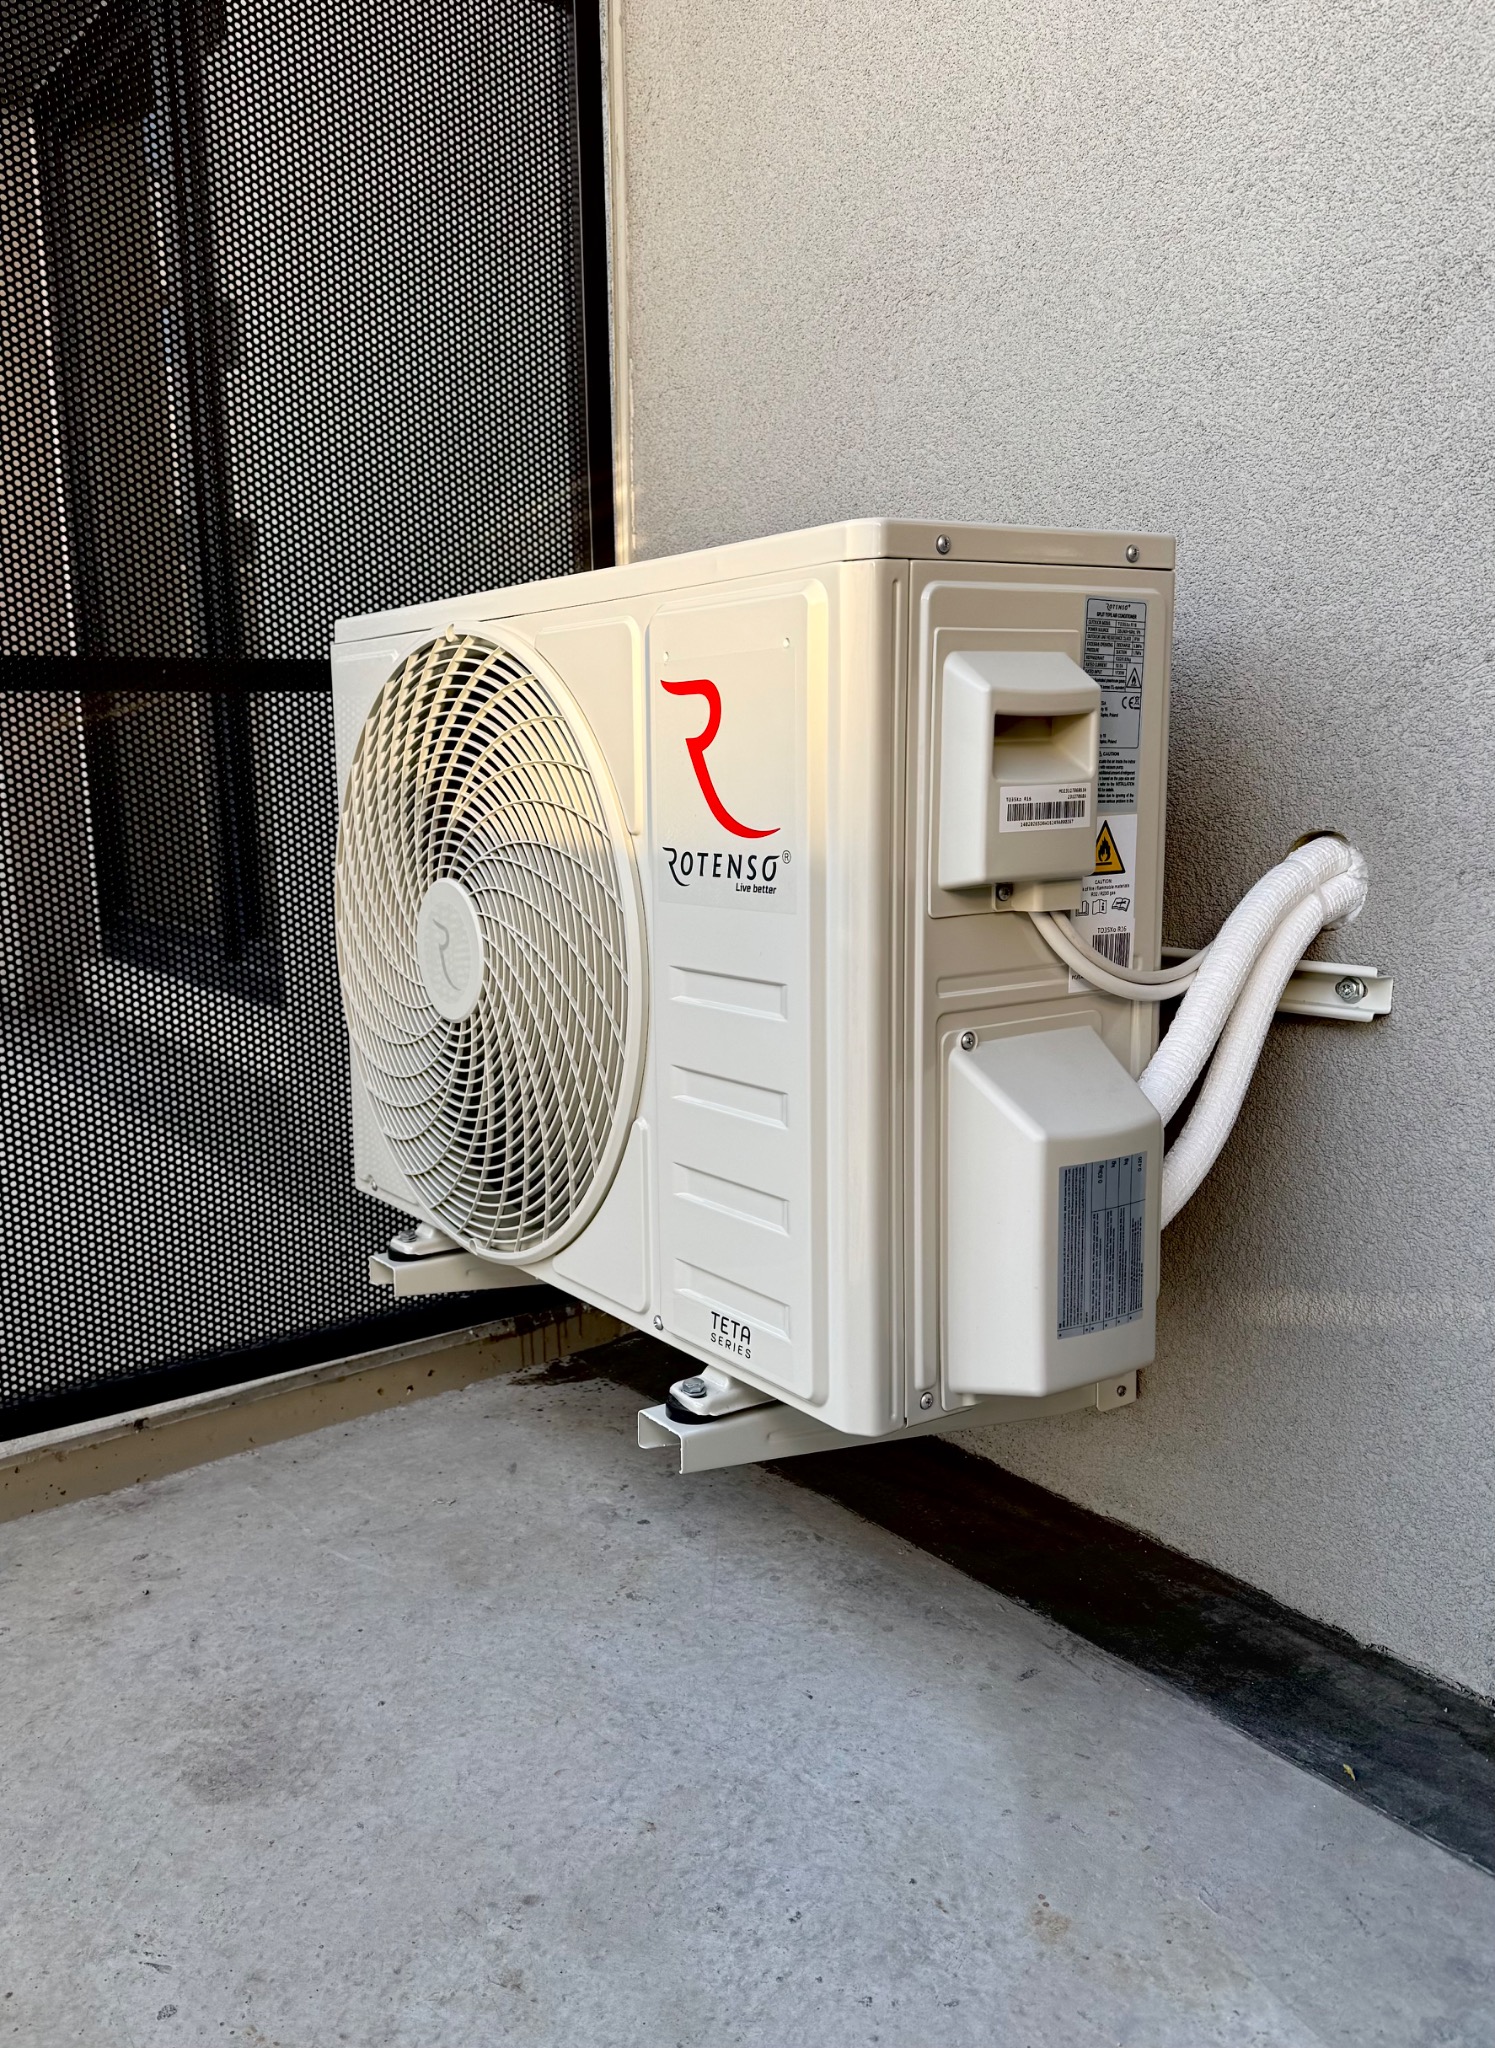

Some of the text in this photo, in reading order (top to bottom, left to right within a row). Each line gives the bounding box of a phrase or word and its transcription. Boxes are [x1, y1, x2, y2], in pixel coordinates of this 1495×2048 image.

[660, 679, 781, 839] R
[736, 882, 777, 894] Live better
[711, 1311, 750, 1345] TETA
[710, 1332, 751, 1358] SERIES
